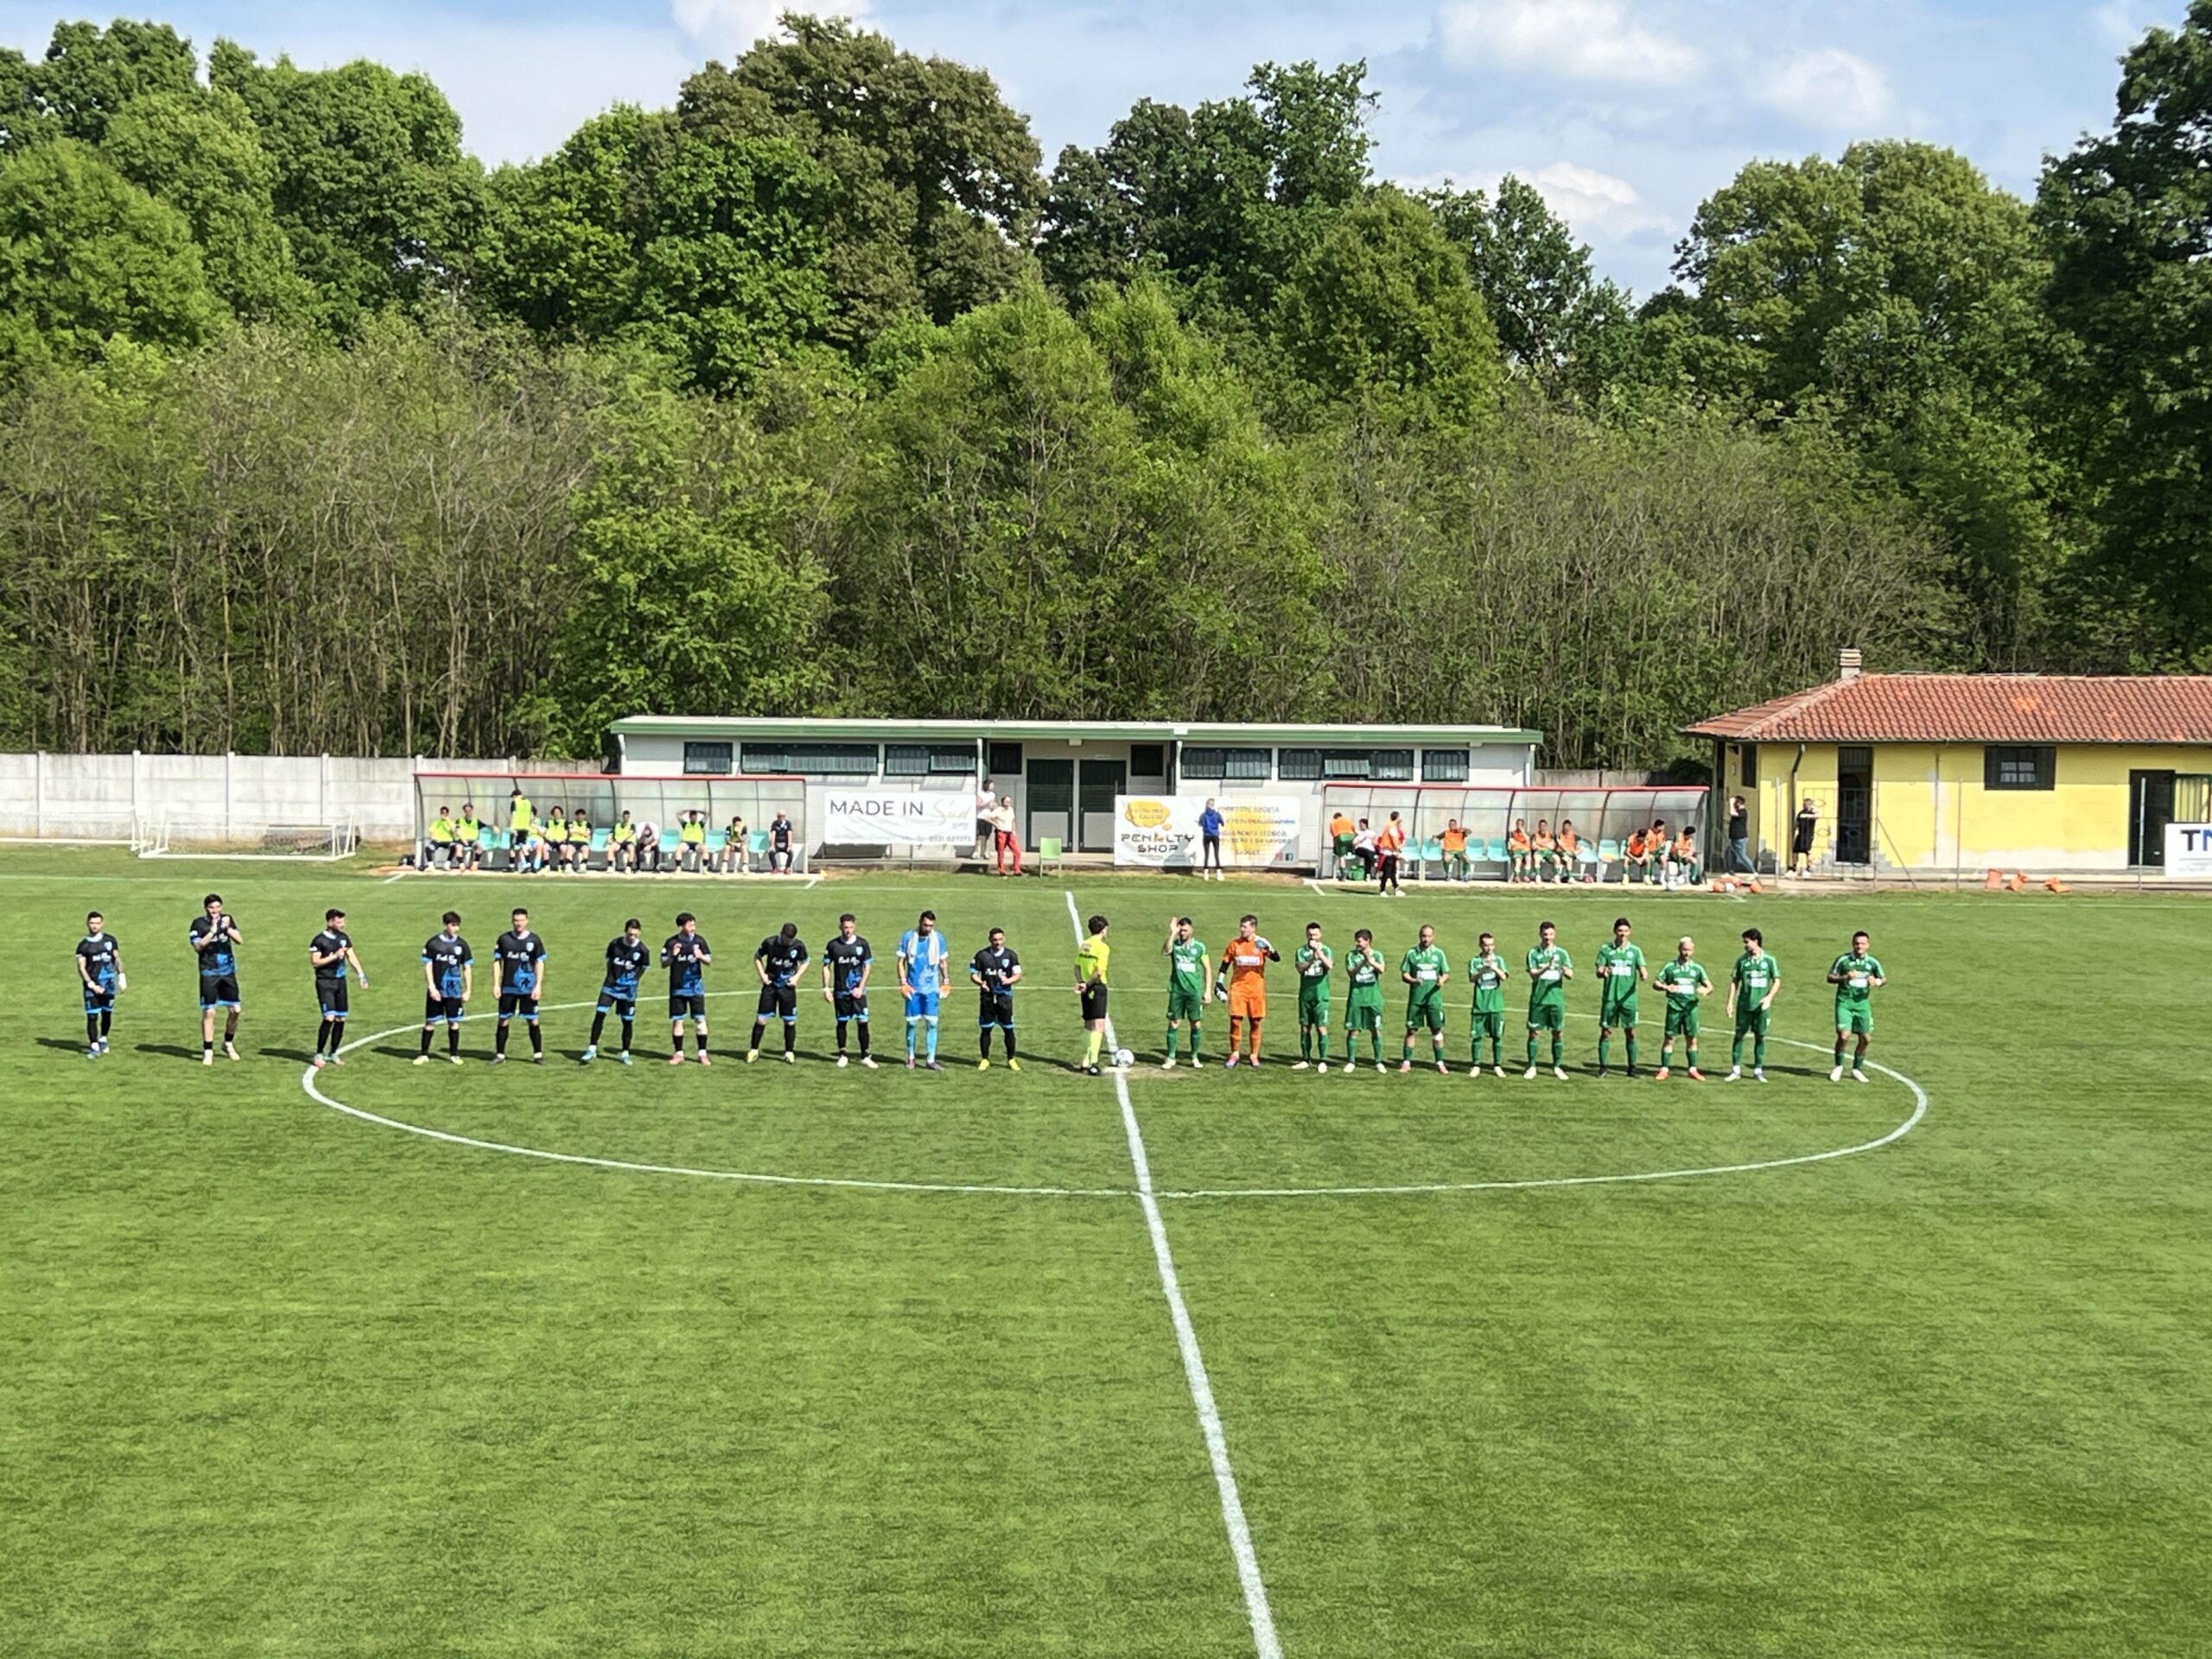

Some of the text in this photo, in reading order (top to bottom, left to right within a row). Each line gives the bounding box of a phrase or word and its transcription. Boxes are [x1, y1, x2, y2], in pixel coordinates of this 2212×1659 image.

[830, 799, 894, 816] MADE
[903, 800, 924, 816] IN
[1137, 844, 1179, 853] SHOP
